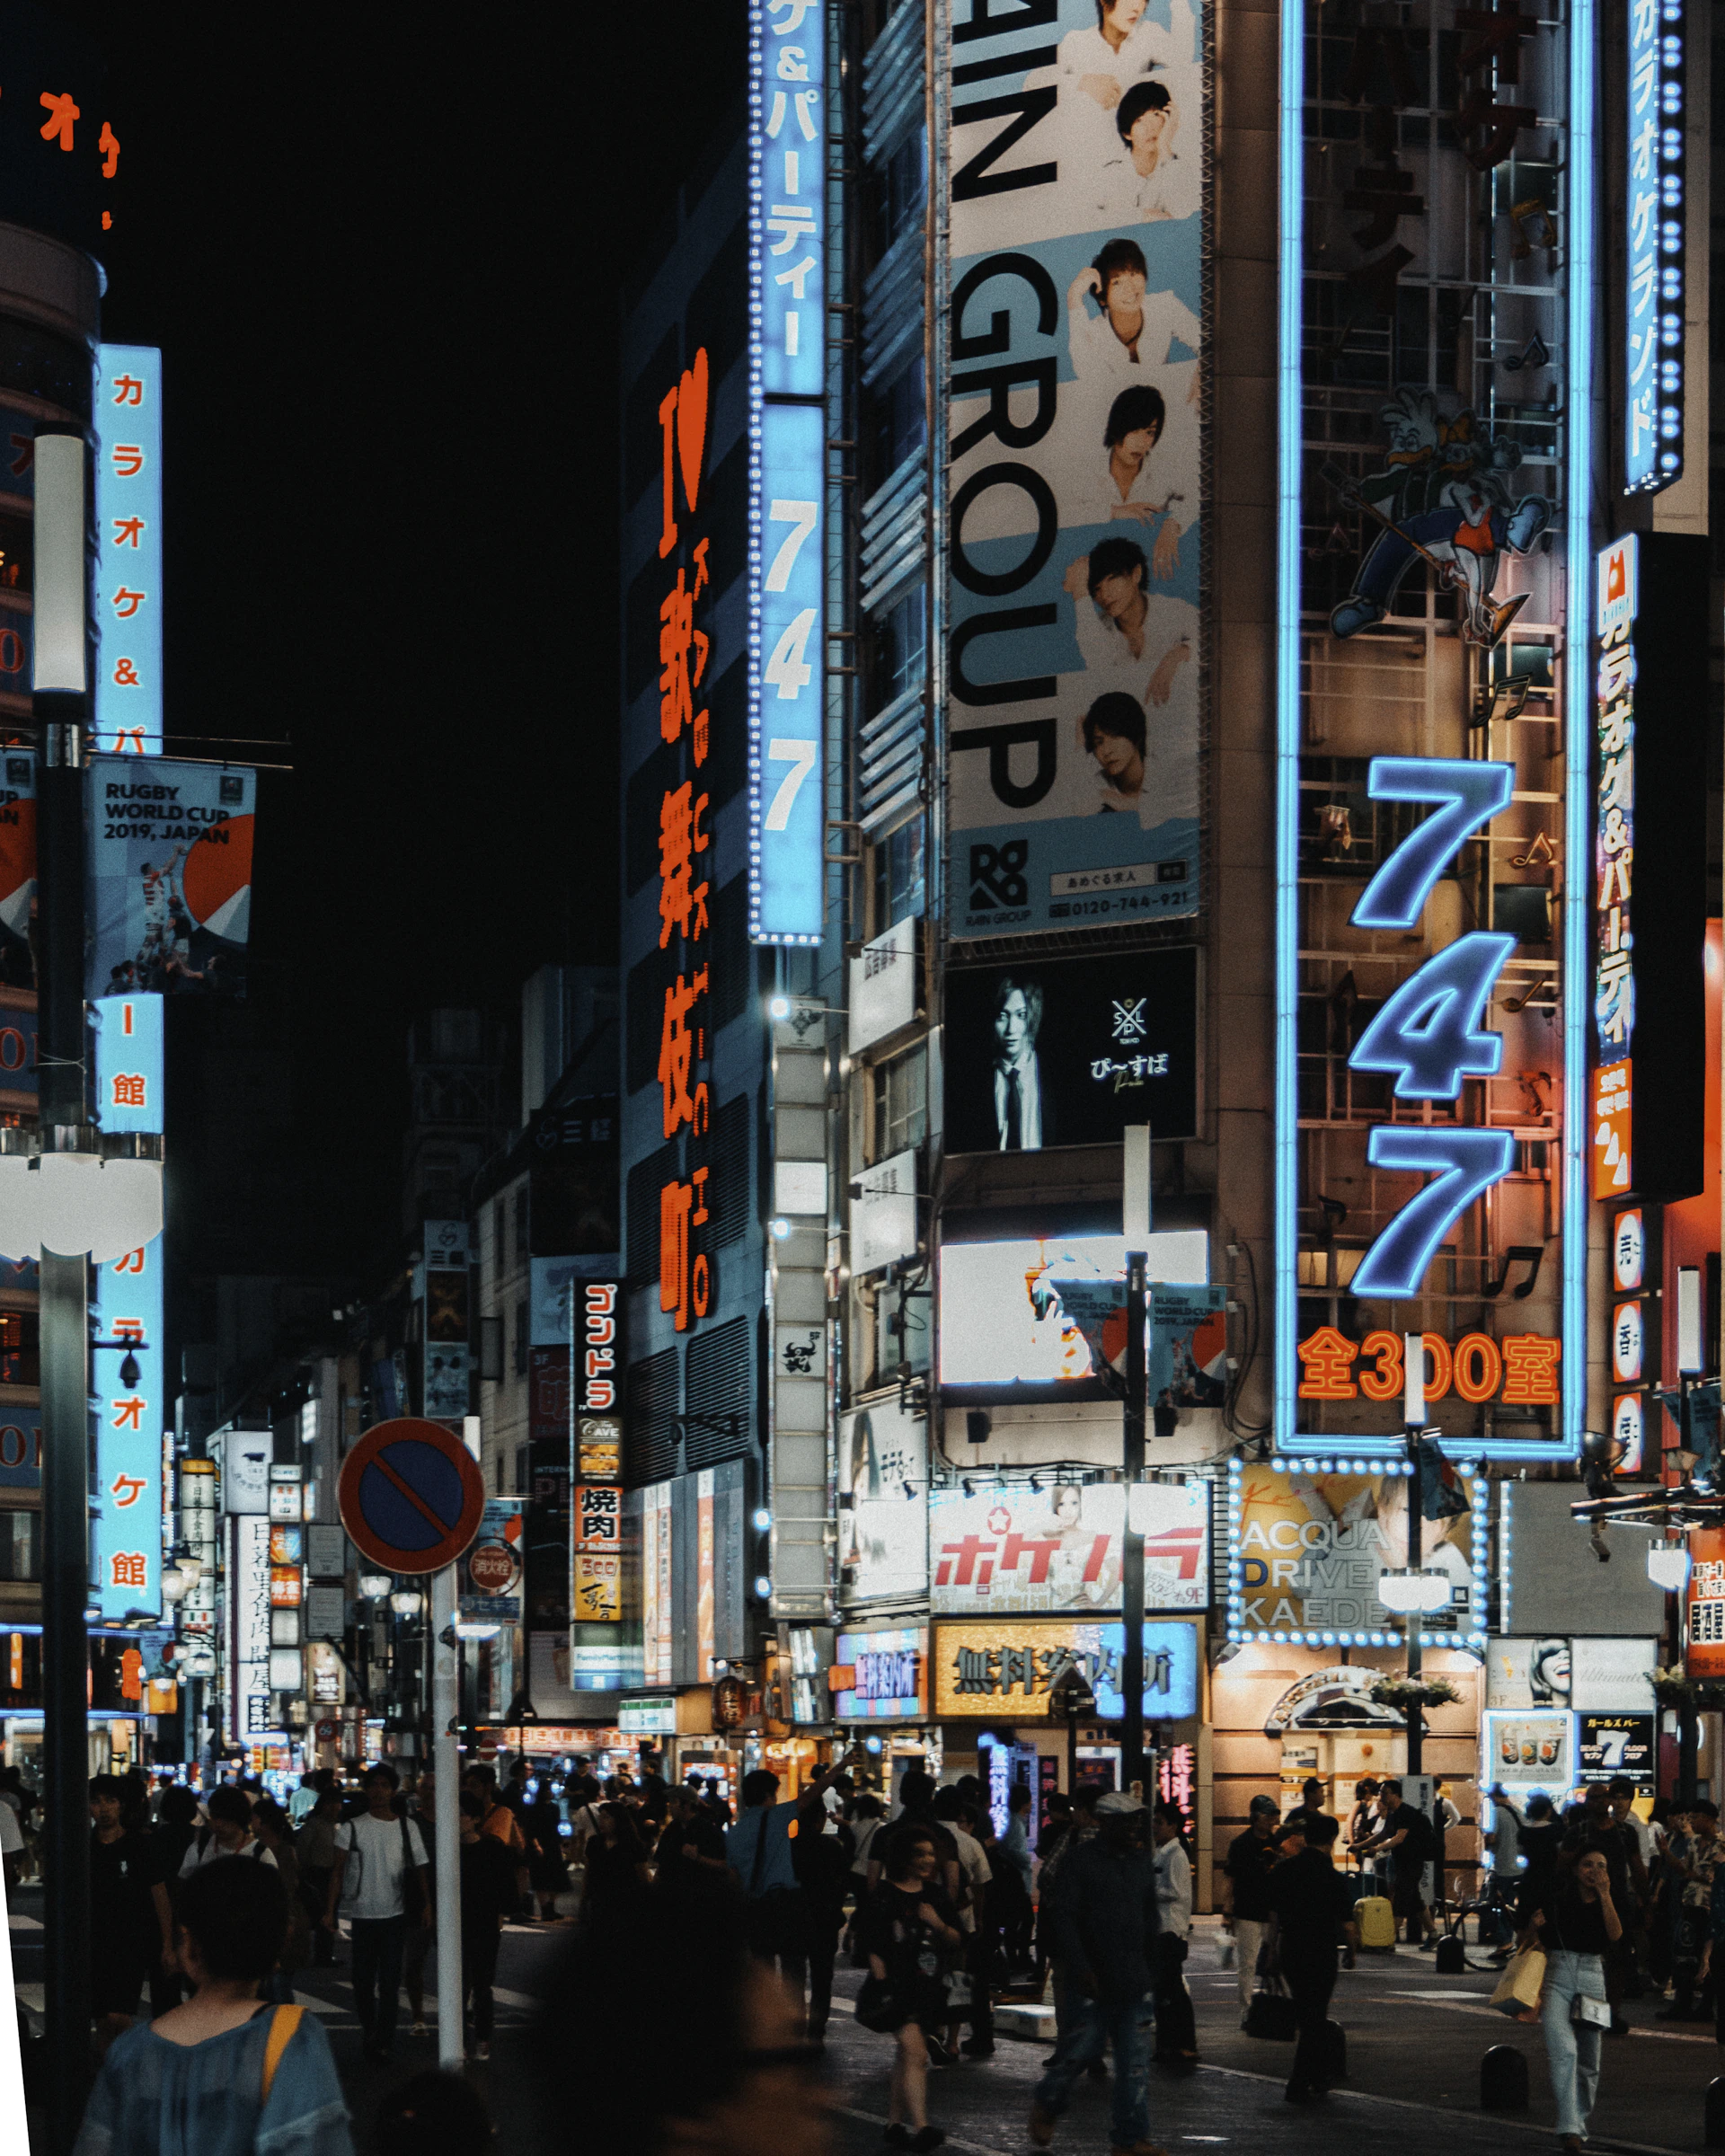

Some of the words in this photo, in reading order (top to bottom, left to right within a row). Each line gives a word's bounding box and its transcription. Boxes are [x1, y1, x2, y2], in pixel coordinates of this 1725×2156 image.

[951, 252, 1057, 808] GROUP
[764, 499, 818, 830] 747
[106, 783, 179, 800] RUGBY
[105, 803, 184, 821] WORLD
[186, 807, 230, 824] CUP
[160, 826, 230, 844] JAPAN
[993, 910, 1032, 924] GROUP
[657, 568, 693, 1331] 歌舞伎町
[1348, 756, 1515, 1299] 747
[580, 1489, 617, 1539] 焼肉
[1239, 1519, 1391, 1554] ACQUA
[474, 1558, 509, 1576] 消火栓
[1239, 1558, 1374, 1588] DRIVE
[1238, 1596, 1392, 1629] KAEDE
[1596, 1729, 1632, 1767] 7
